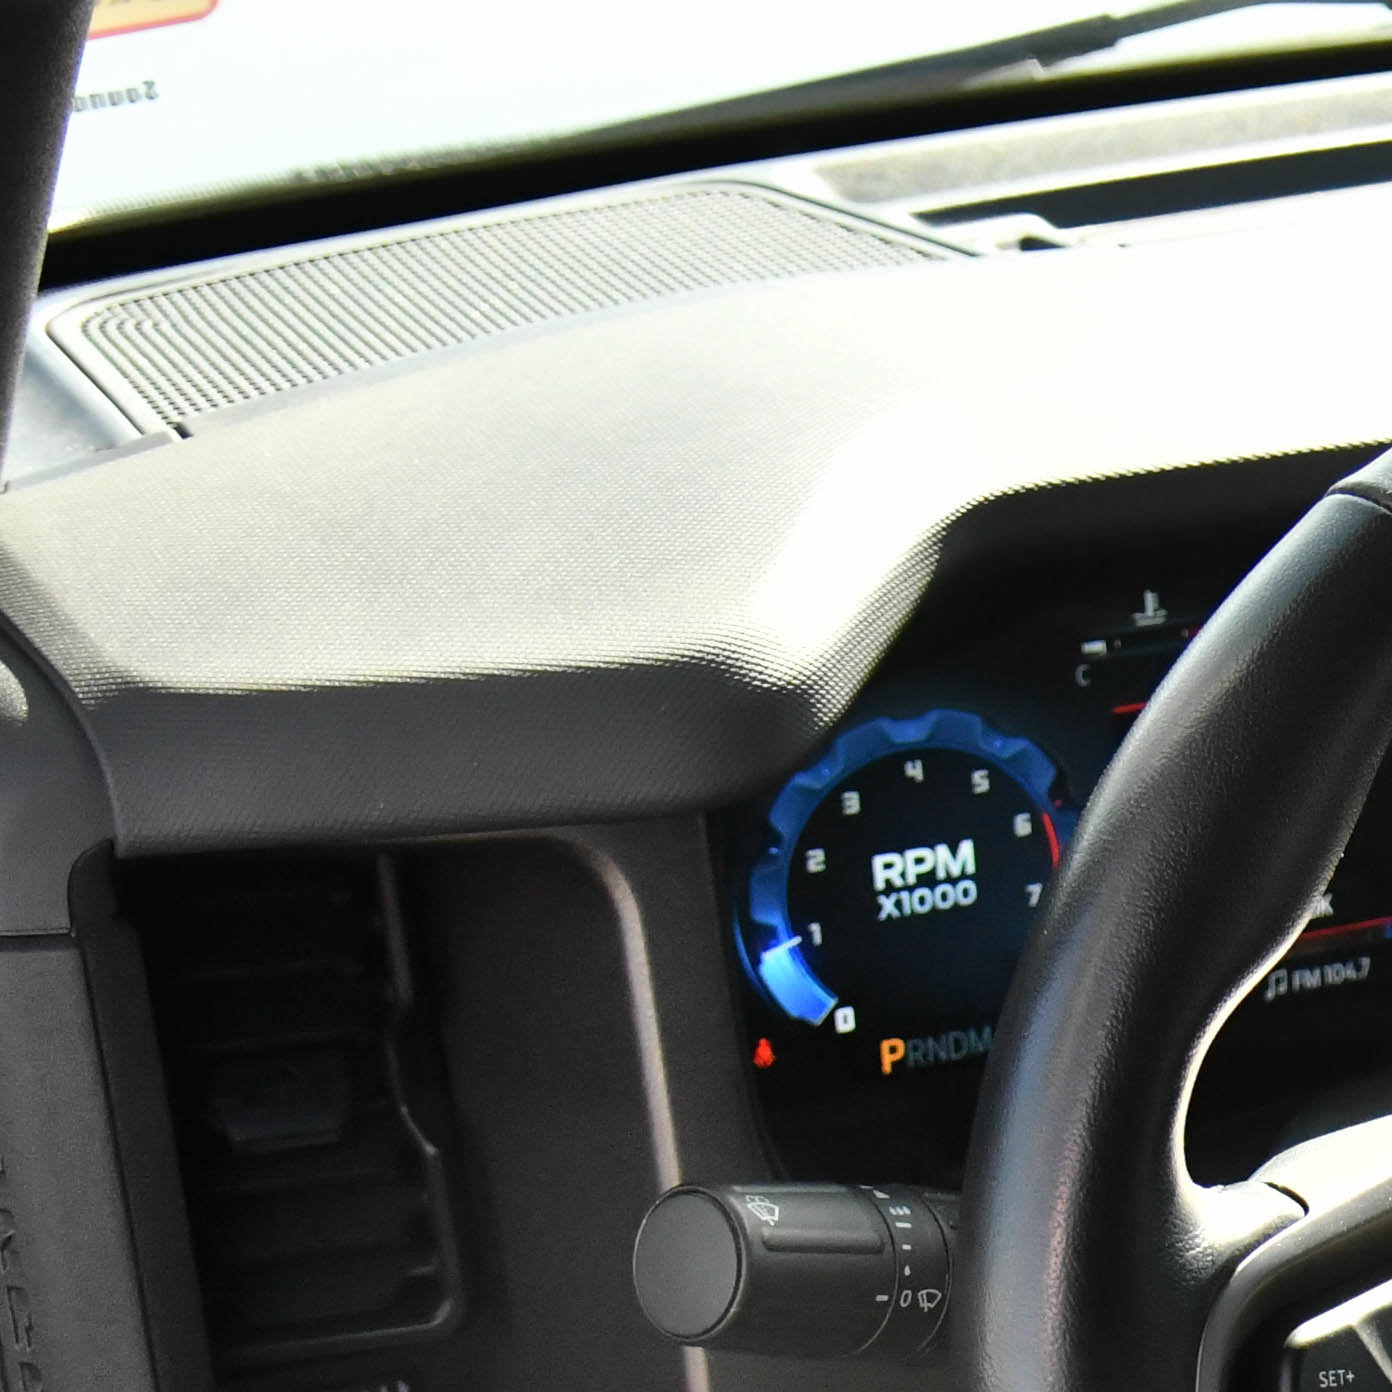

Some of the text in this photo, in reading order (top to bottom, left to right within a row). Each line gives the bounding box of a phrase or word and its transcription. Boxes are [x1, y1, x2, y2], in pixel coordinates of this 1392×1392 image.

[904, 759, 924, 783] 4
[971, 769, 991, 794] 5
[841, 791, 861, 815] 3
[1013, 812, 1032, 837] 6
[806, 848, 827, 873] 2
[871, 838, 976, 892] RPM
[1025, 882, 1043, 907] 7
[808, 922, 823, 946] 1
[1291, 966, 1321, 992] FM
[834, 1006, 856, 1034] 0
